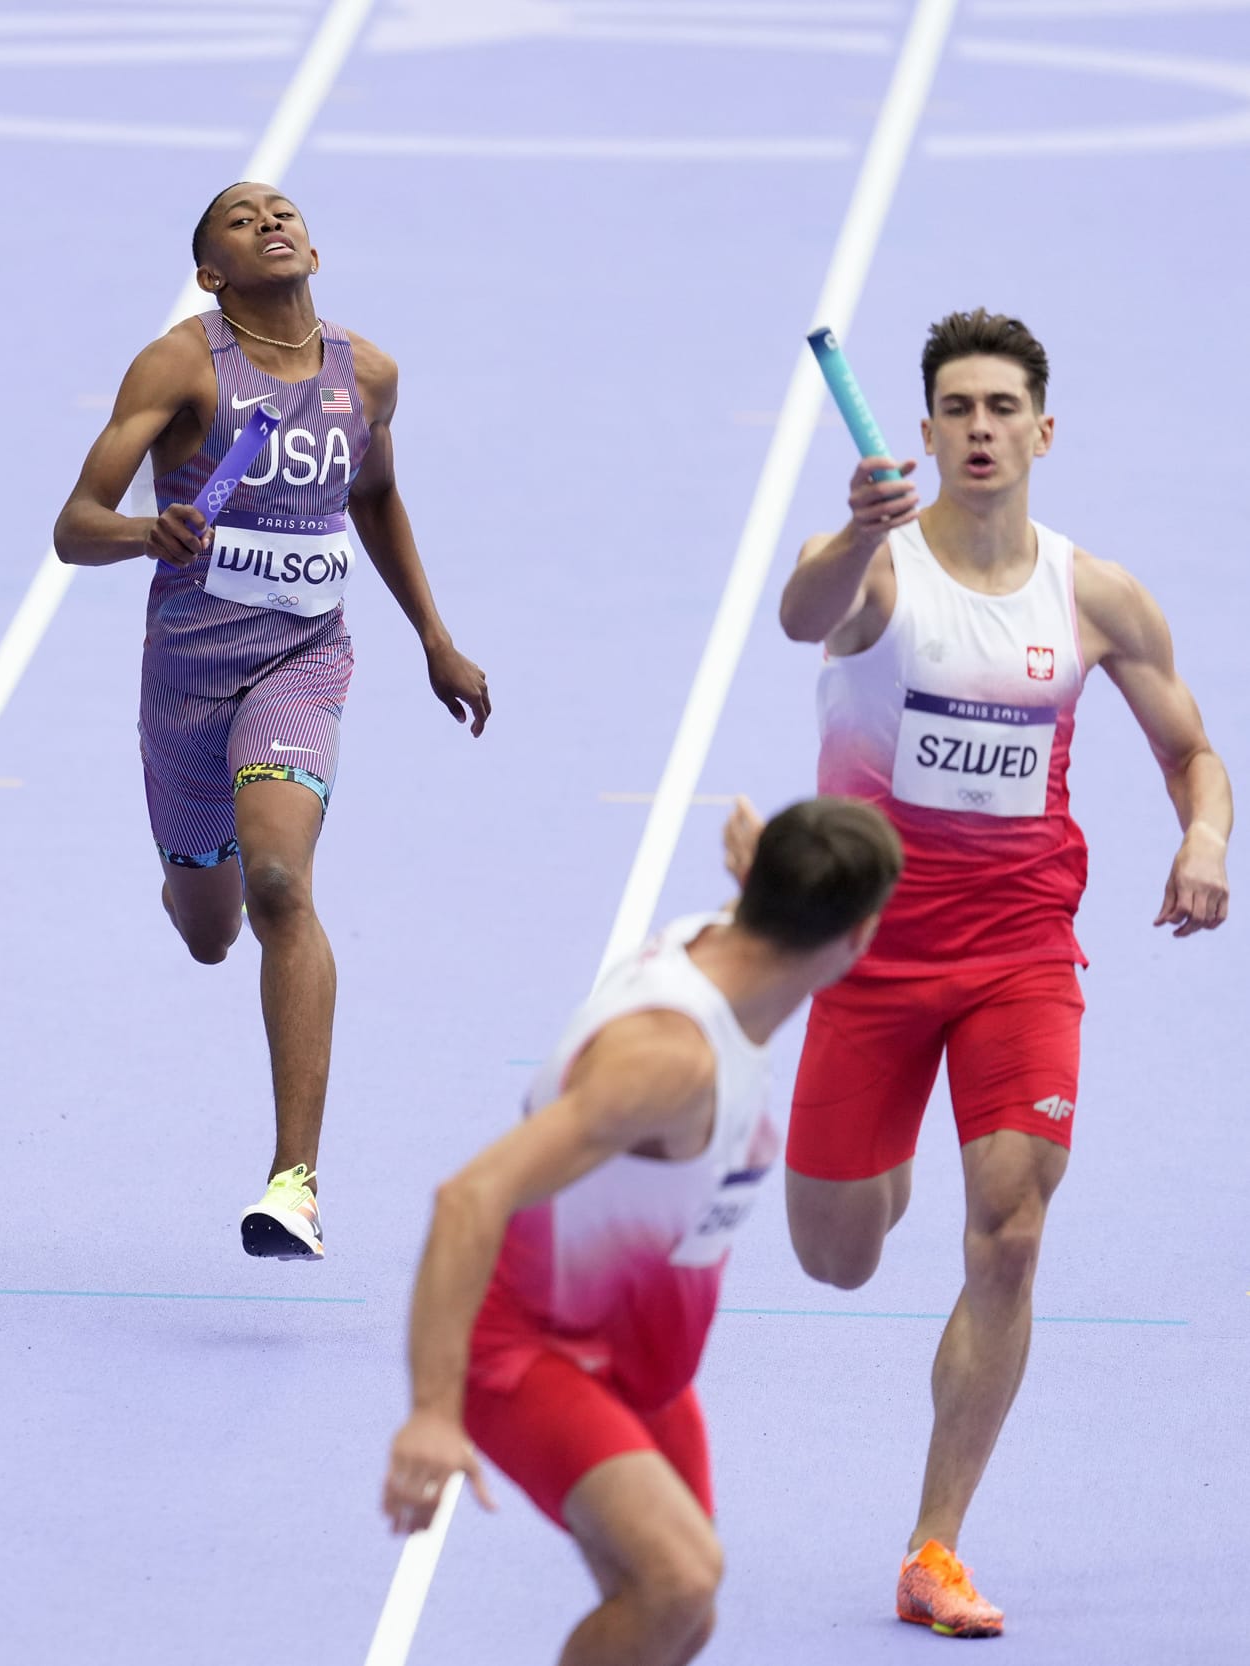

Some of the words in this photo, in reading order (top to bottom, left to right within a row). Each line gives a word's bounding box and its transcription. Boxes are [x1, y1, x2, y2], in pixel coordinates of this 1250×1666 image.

[234, 427, 351, 486] USA
[257, 516, 295, 529] PARIS
[300, 519, 328, 530] 2024
[217, 546, 348, 585] WILSON
[948, 701, 989, 719] PARIS
[916, 734, 1038, 779] SZWED
